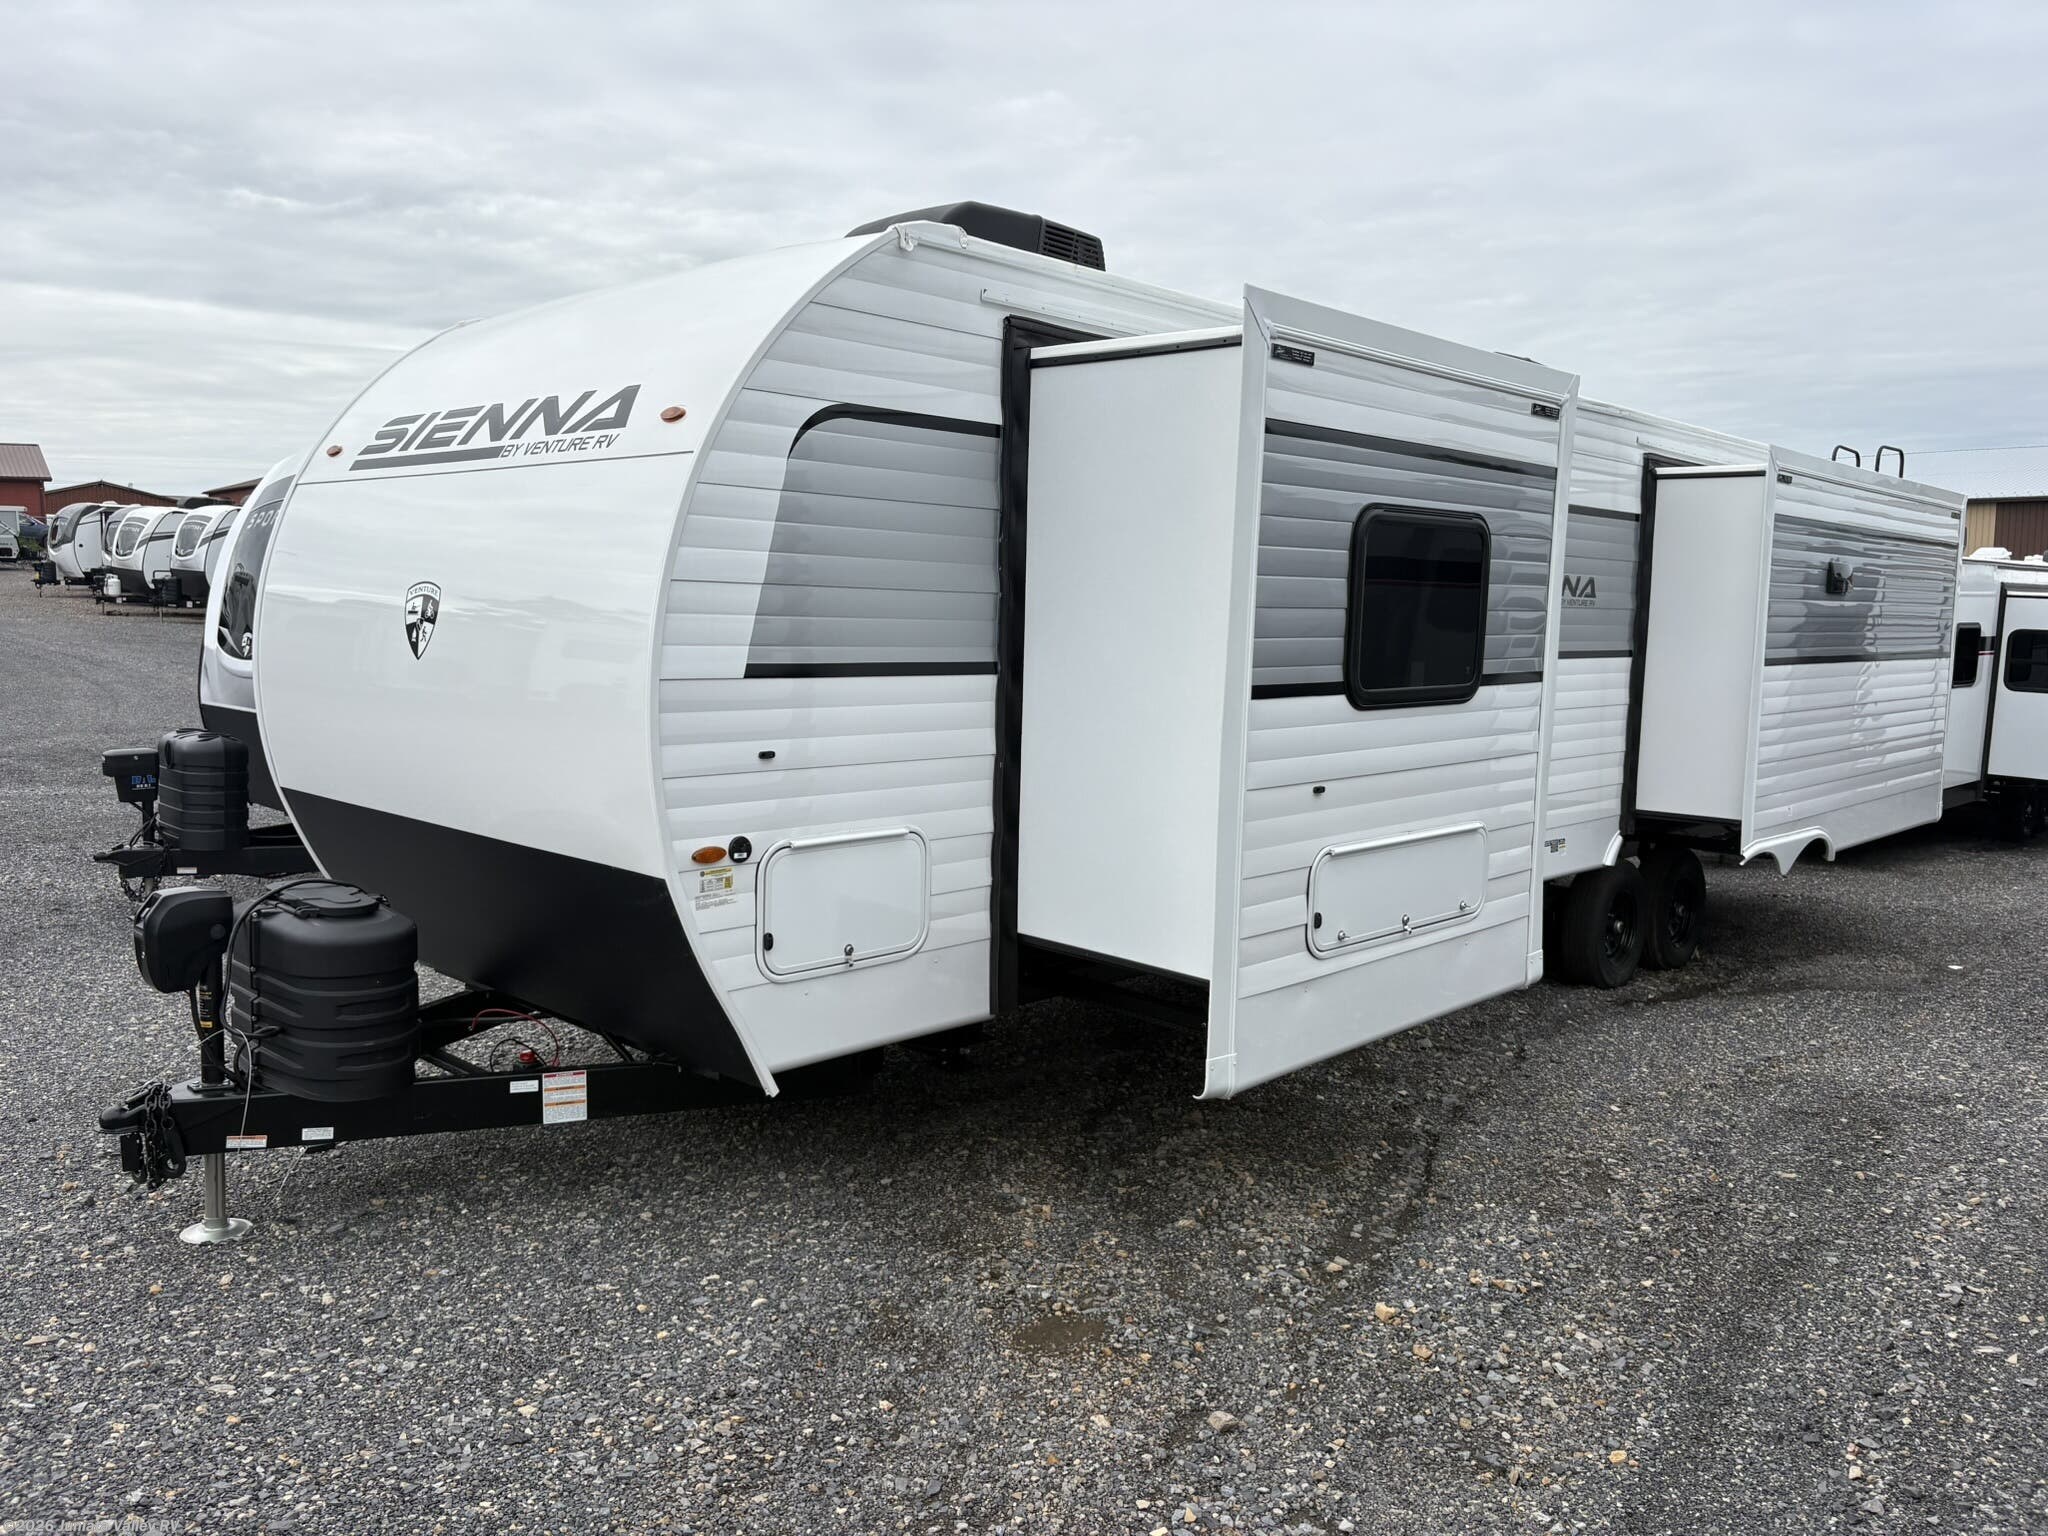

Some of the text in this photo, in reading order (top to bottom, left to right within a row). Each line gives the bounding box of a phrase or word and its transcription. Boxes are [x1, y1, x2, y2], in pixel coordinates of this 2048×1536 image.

[358, 384, 641, 456] SIENNA
[501, 433, 620, 458] BY VENTURE RV
[410, 585, 439, 596] VENTURE
